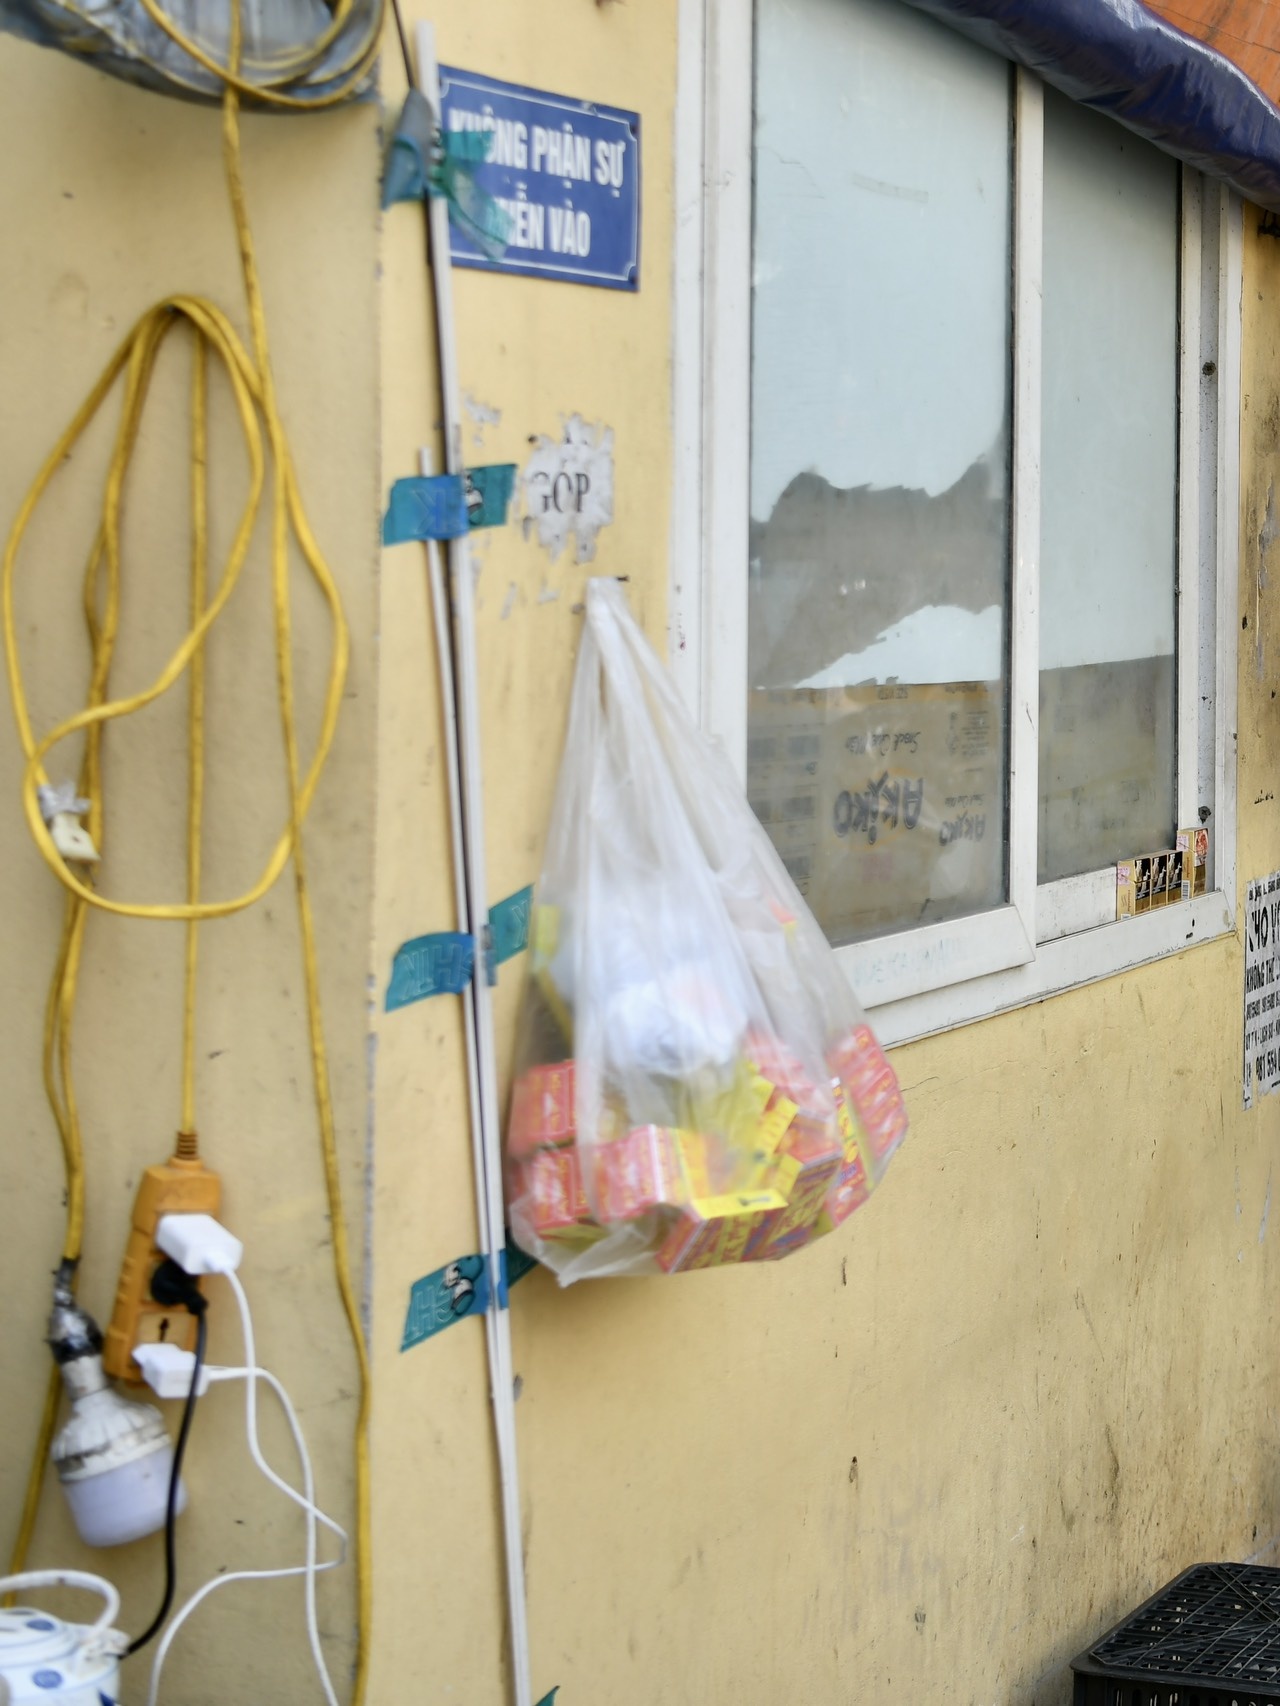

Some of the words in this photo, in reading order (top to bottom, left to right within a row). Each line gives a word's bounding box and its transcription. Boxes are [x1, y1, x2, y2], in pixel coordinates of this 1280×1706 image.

[531, 121, 591, 189] PHẬN
[594, 139, 627, 198] SỰ
[548, 198, 592, 258] VÀO
